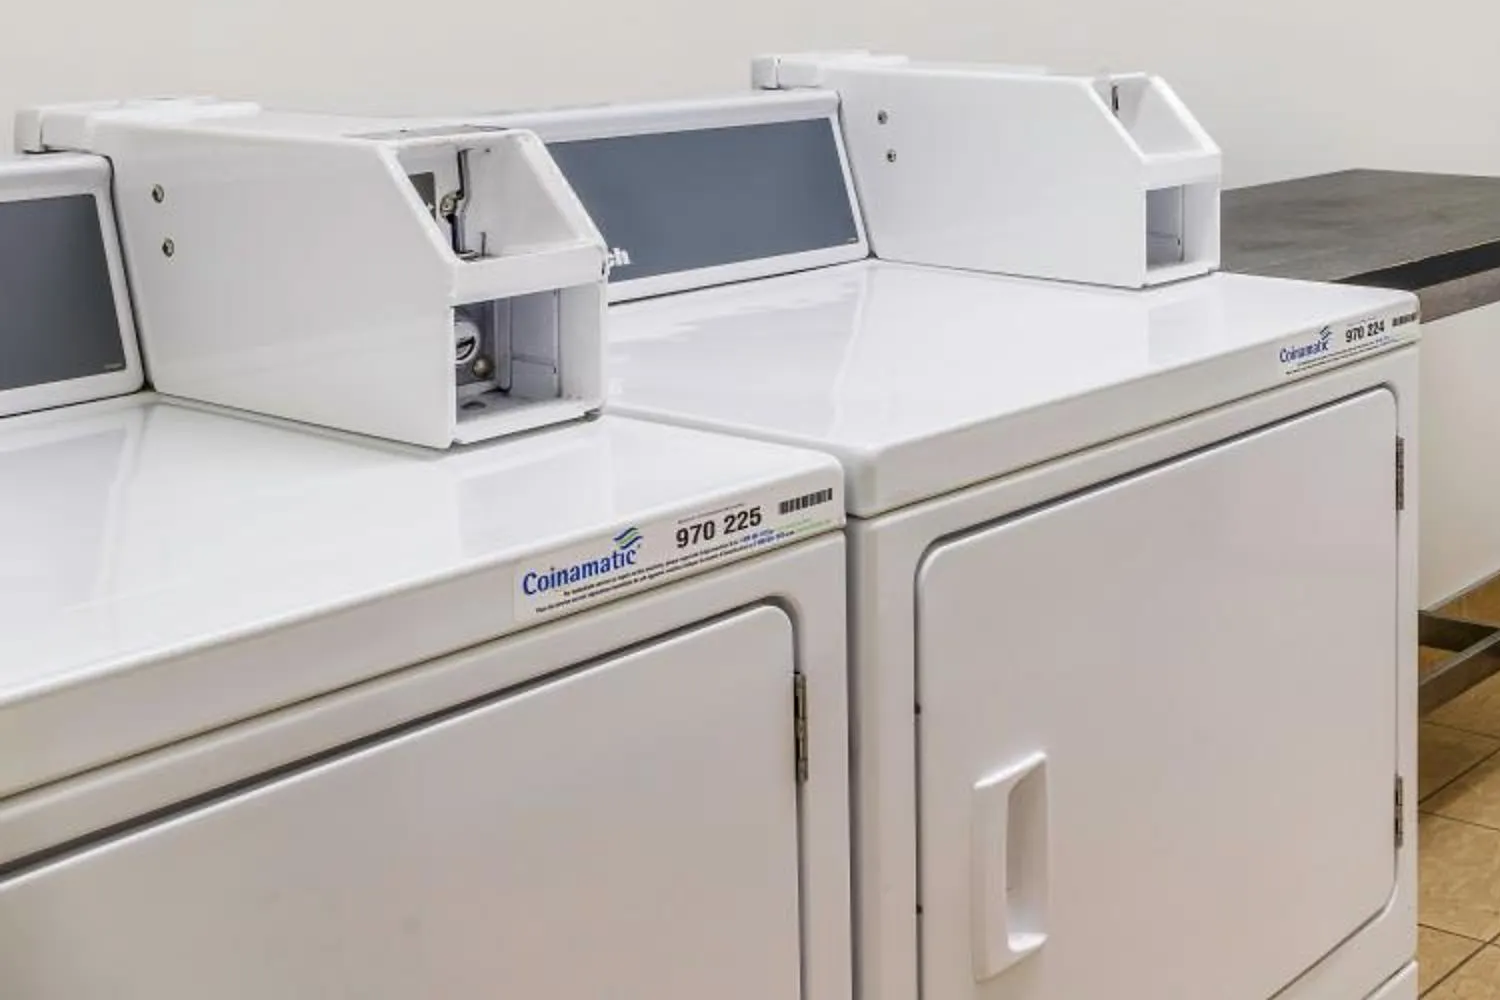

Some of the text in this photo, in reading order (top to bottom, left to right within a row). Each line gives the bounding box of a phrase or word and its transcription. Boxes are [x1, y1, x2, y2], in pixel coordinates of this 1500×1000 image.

[1345, 325, 1365, 343] 970
[1367, 319, 1385, 337] 224
[675, 519, 716, 549] 970
[723, 505, 763, 535] 225
[522, 548, 637, 596] Coinamatic
